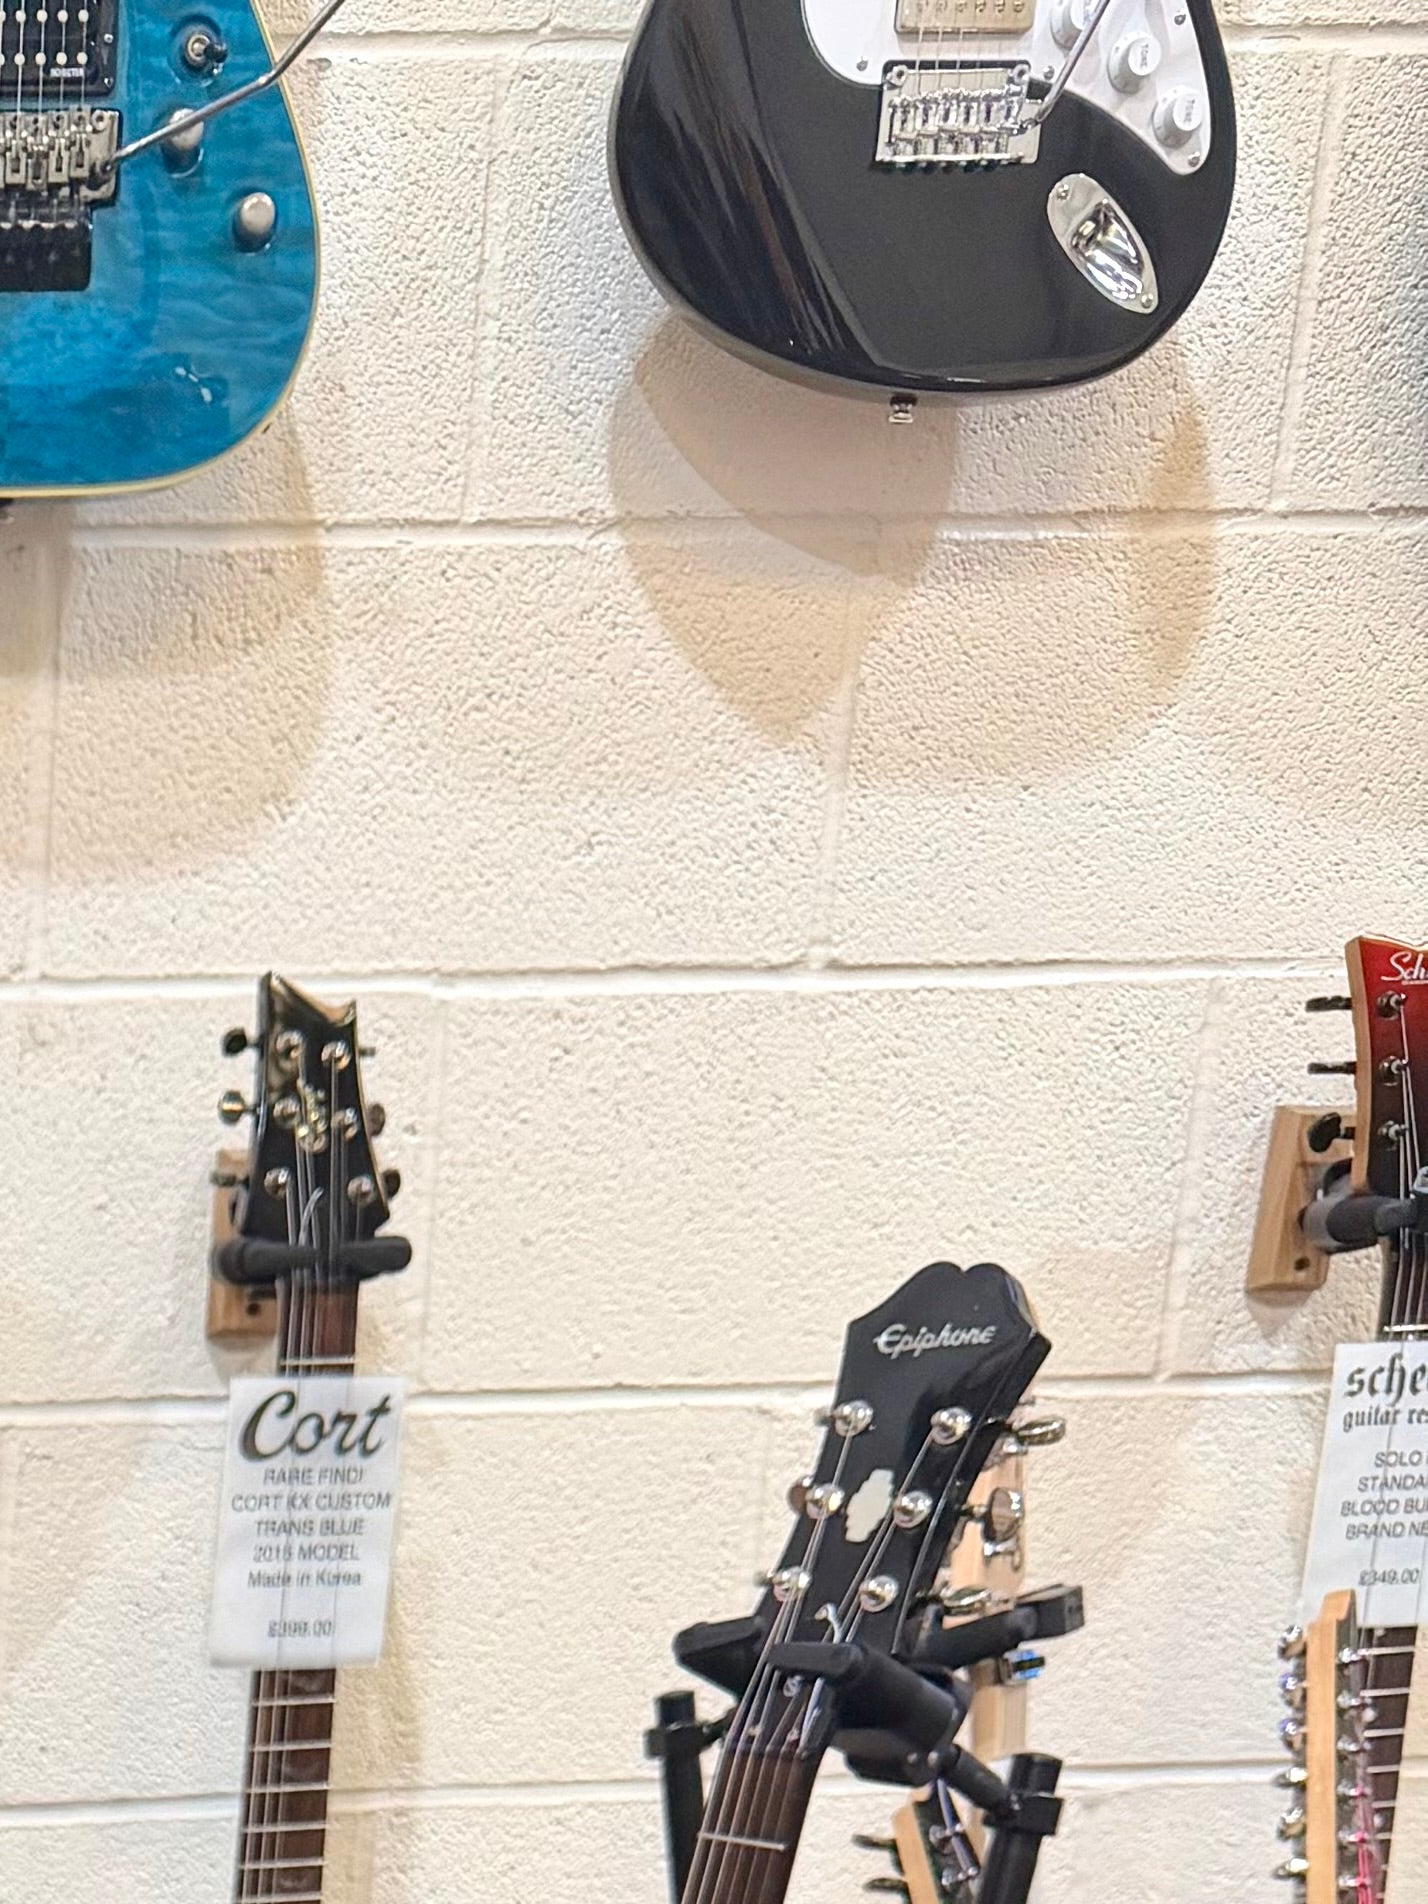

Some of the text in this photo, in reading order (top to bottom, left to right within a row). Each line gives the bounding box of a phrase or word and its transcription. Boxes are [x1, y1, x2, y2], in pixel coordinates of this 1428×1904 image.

[1381, 951, 1428, 981] Sch
[873, 1321, 997, 1360] Epiphone
[239, 1389, 391, 1462] Cort
[1343, 1405, 1400, 1433] guitar
[1374, 1450, 1422, 1469] SOLO
[263, 1467, 313, 1486] RARE
[1357, 1475, 1428, 1493] STANDA
[231, 1494, 282, 1513] CORT
[315, 1491, 392, 1510] CUSTOM
[1340, 1498, 1428, 1518] BLOOD BU
[254, 1517, 364, 1537] TRANS BLUE
[1345, 1523, 1406, 1541] BRAND
[298, 1544, 360, 1562] MODEL
[247, 1570, 292, 1589] Made
